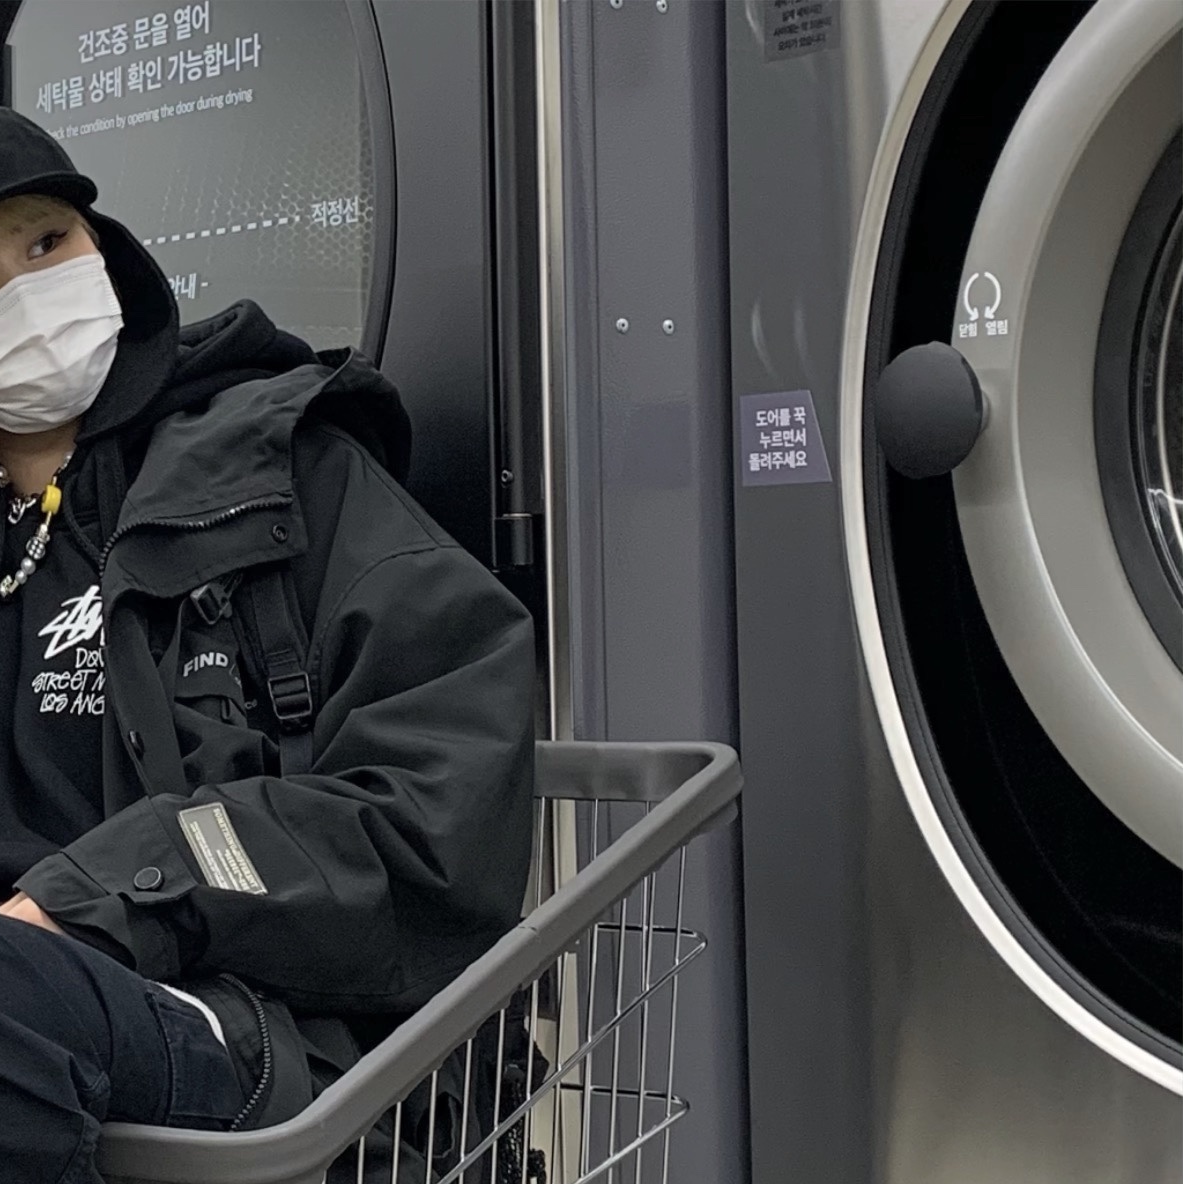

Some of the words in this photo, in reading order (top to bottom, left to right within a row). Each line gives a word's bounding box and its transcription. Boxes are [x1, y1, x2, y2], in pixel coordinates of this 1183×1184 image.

[78, 23, 128, 63] 건조중
[133, 13, 168, 50] 문을
[174, 1, 210, 40] 열어
[36, 75, 84, 113] 세탁물
[89, 66, 122, 103] 상태
[128, 56, 161, 93] 확인
[168, 33, 261, 84] 가능합니다
[47, 126, 65, 141] heck
[66, 125, 78, 137] the
[80, 117, 115, 135] condition
[116, 115, 127, 129] by
[128, 108, 159, 126] opening
[161, 104, 174, 118] the
[176, 100, 195, 115] door
[197, 94, 224, 111] during
[225, 87, 253, 106] drying
[310, 195, 359, 228] 적정선
[985, 319, 1008, 336] 열림
[756, 407, 791, 427] 도어를
[793, 406, 806, 425] 꾹
[759, 427, 806, 449] 누르면서
[748, 450, 808, 472] 돌려주세요
[183, 651, 229, 677] FIND
[40, 692, 69, 713] LOS
